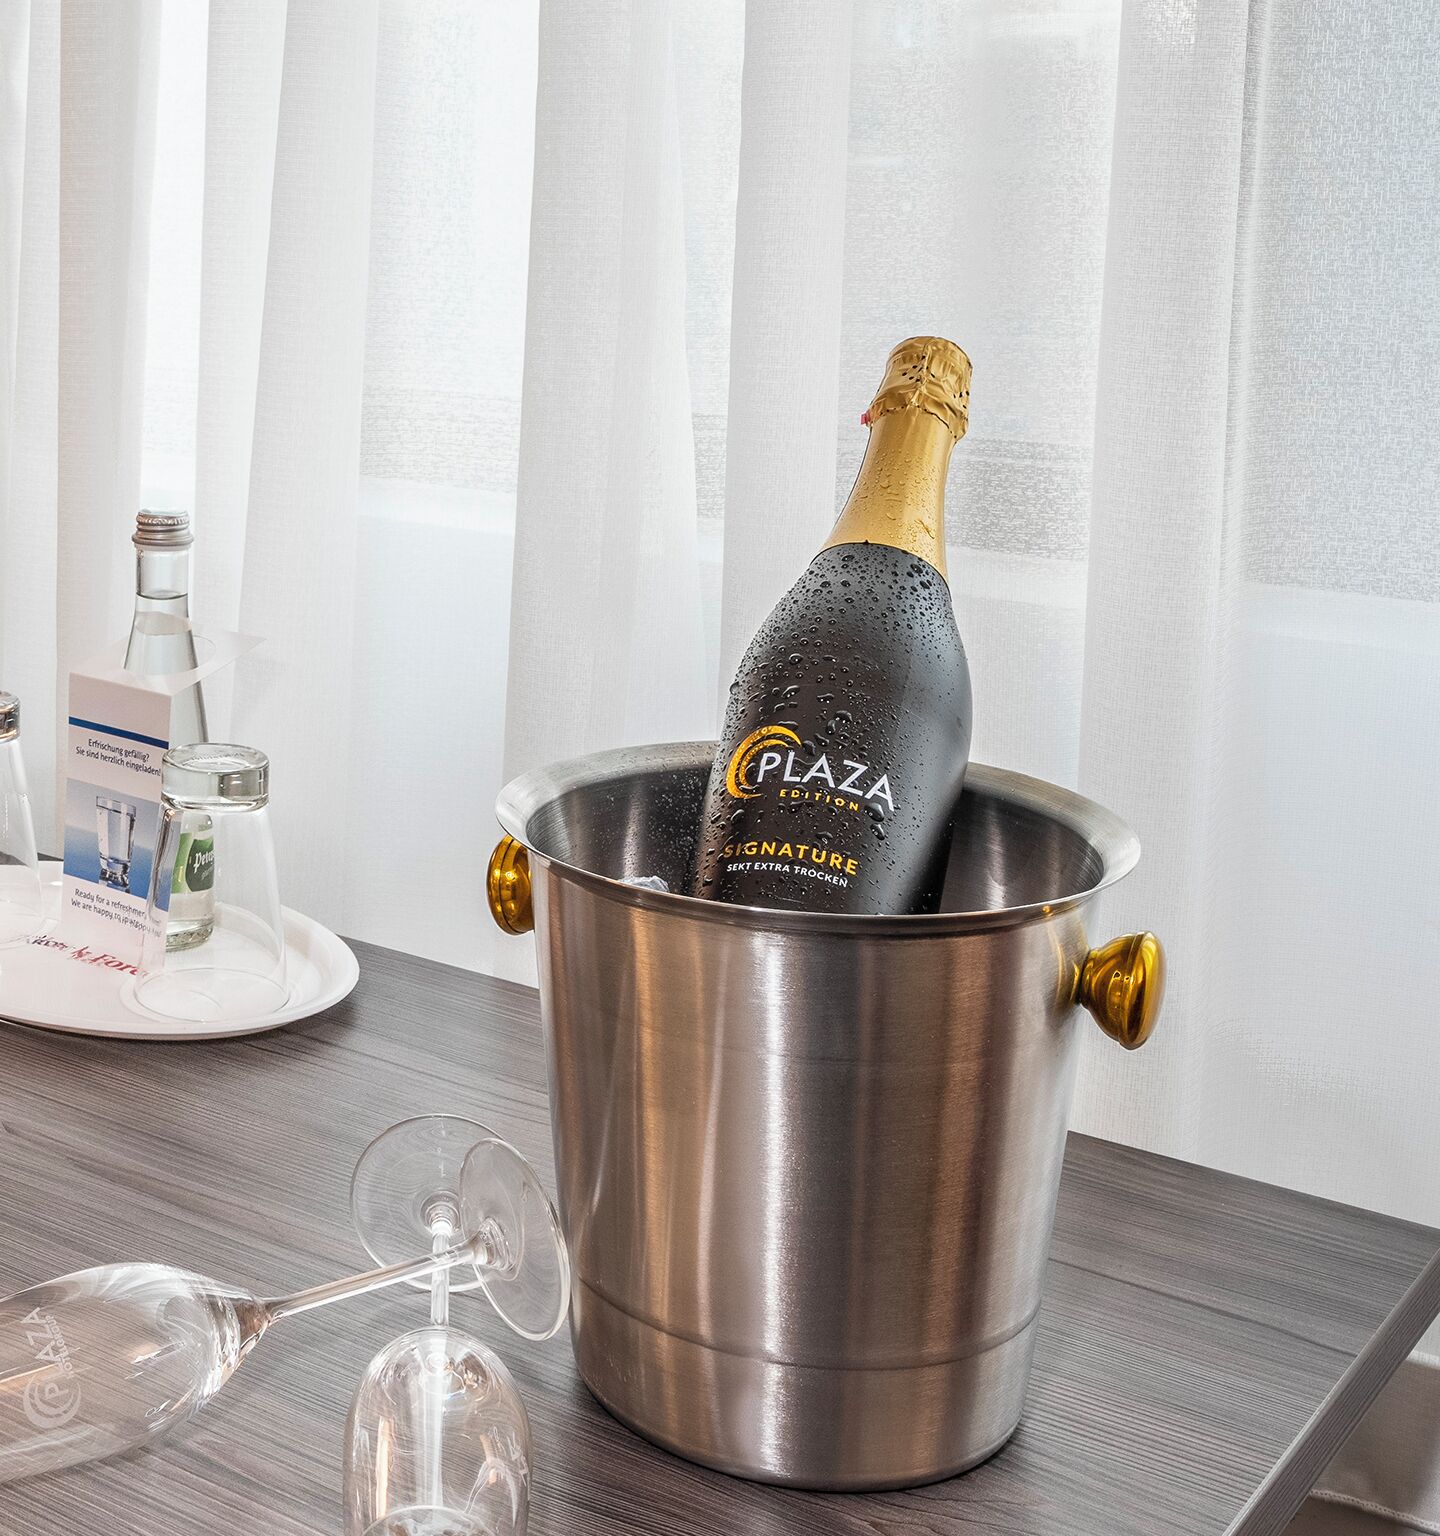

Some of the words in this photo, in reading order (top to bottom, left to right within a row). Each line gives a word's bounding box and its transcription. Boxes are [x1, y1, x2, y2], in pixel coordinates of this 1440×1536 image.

[76, 746, 85, 756] Sie
[86, 749, 99, 760] sind
[100, 752, 125, 766] herzlich
[88, 738, 124, 756] Erfrischung
[756, 750, 894, 812] PLAZA
[780, 788, 859, 812] EDITION
[722, 840, 860, 876] SIGNATURE
[726, 861, 753, 872] SEKT
[754, 862, 790, 873] EXTRA
[794, 865, 848, 888] TROCKEN
[74, 888, 95, 901] Ready
[96, 894, 105, 904] for
[71, 898, 81, 908] We
[82, 902, 93, 911] are
[94, 904, 114, 920] happy
